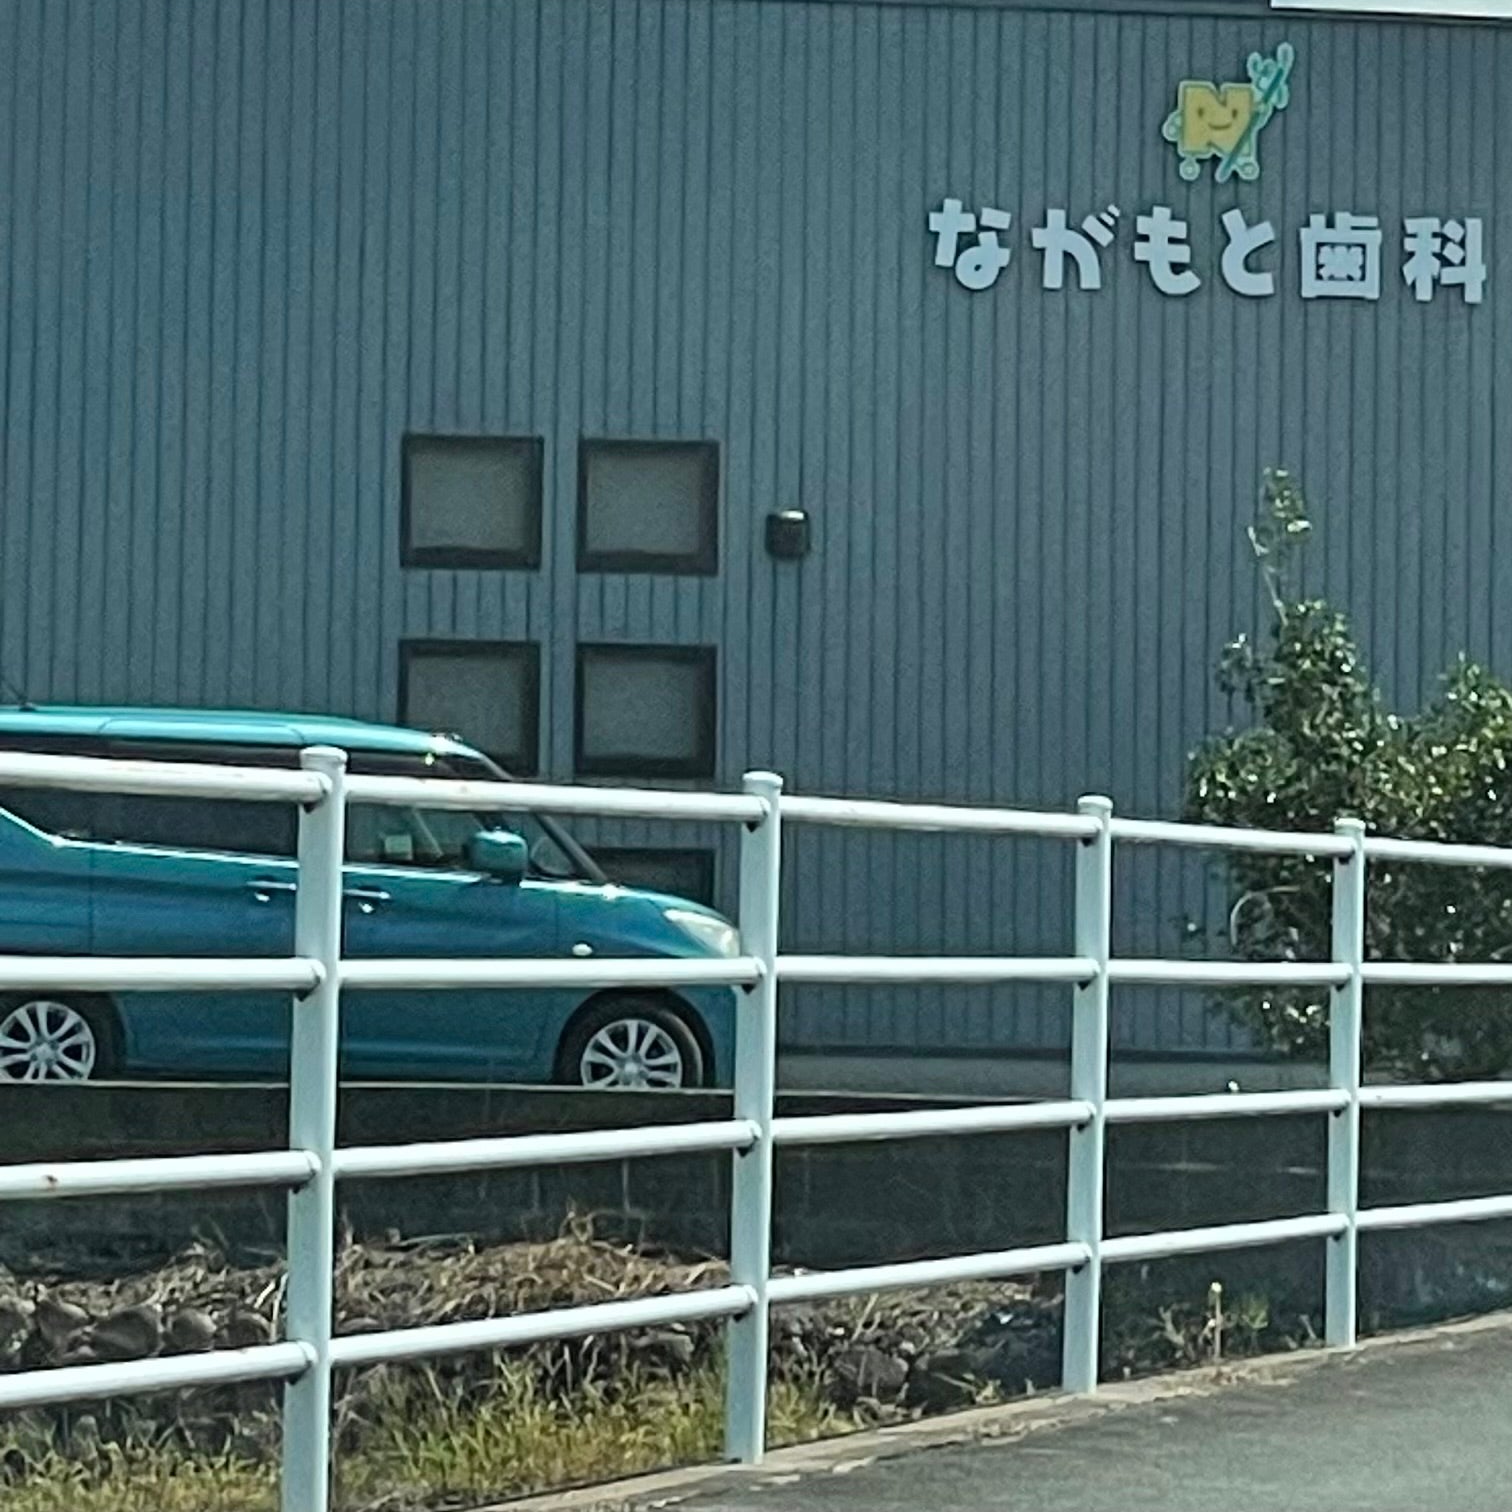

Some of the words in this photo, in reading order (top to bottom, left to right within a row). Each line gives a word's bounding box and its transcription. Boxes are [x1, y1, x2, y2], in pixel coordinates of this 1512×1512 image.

[927, 198, 1487, 304] ながもと歯科
